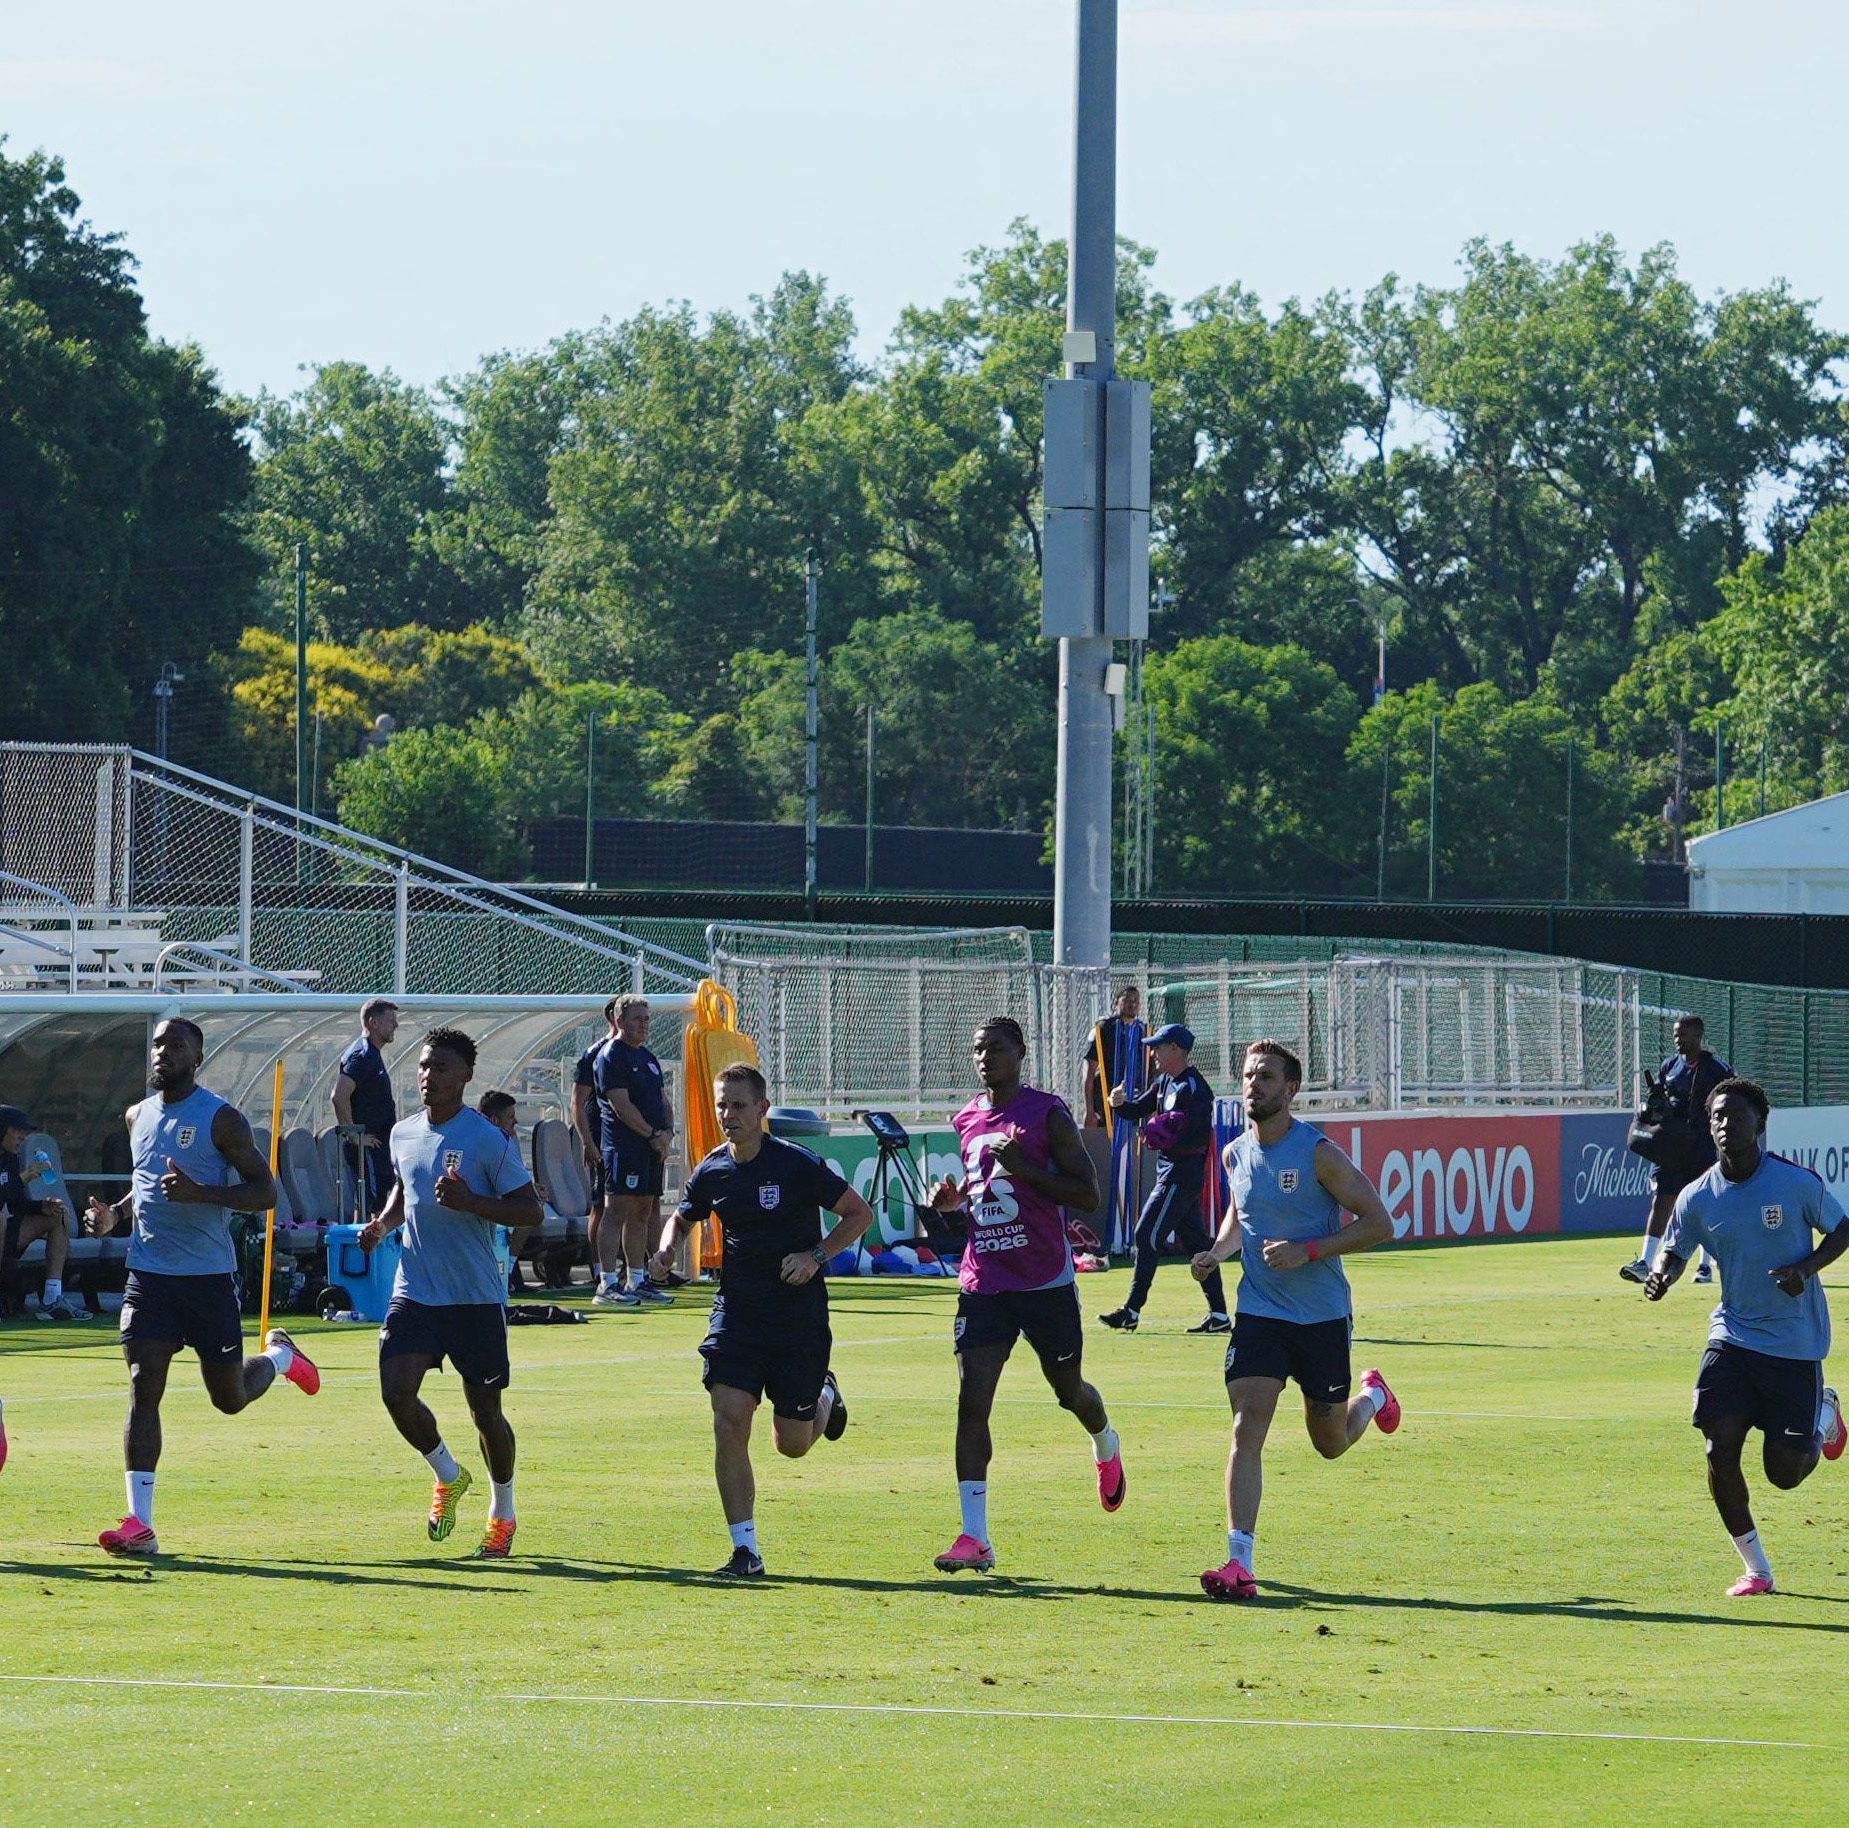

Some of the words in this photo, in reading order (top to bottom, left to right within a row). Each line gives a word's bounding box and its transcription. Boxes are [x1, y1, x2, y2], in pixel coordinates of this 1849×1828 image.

[1825, 1145, 1849, 1183] OF
[982, 1206, 1006, 1218] FIFA
[1004, 1224, 1025, 1235] CUP
[974, 1233, 1029, 1254] 2026
